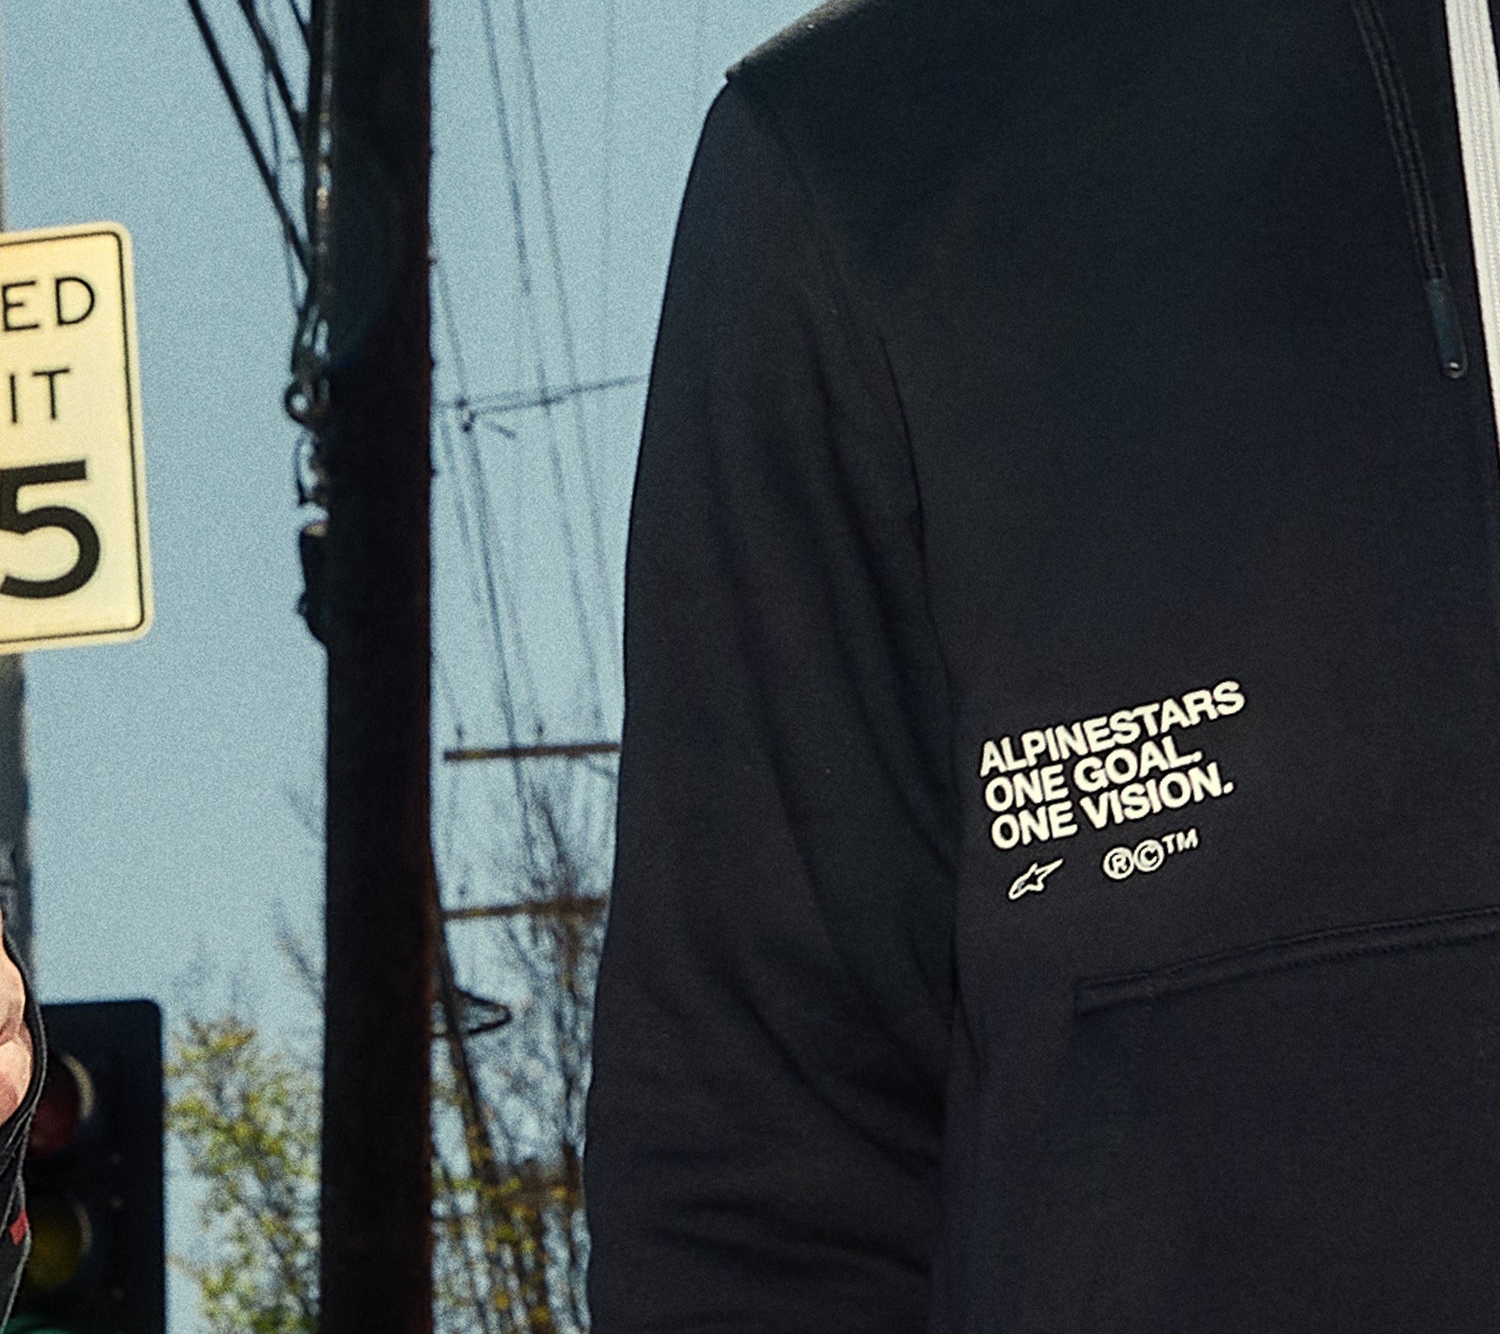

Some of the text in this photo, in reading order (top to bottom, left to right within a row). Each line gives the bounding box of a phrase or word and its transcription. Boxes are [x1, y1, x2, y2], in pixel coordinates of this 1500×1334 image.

[2, 276, 95, 331] ED
[9, 368, 70, 423] IT
[0, 459, 101, 599] 5
[979, 680, 1246, 777] ALPINESTARS
[984, 735, 1203, 812] ONE GOAL.
[991, 762, 1235, 850] ONE VISION.
